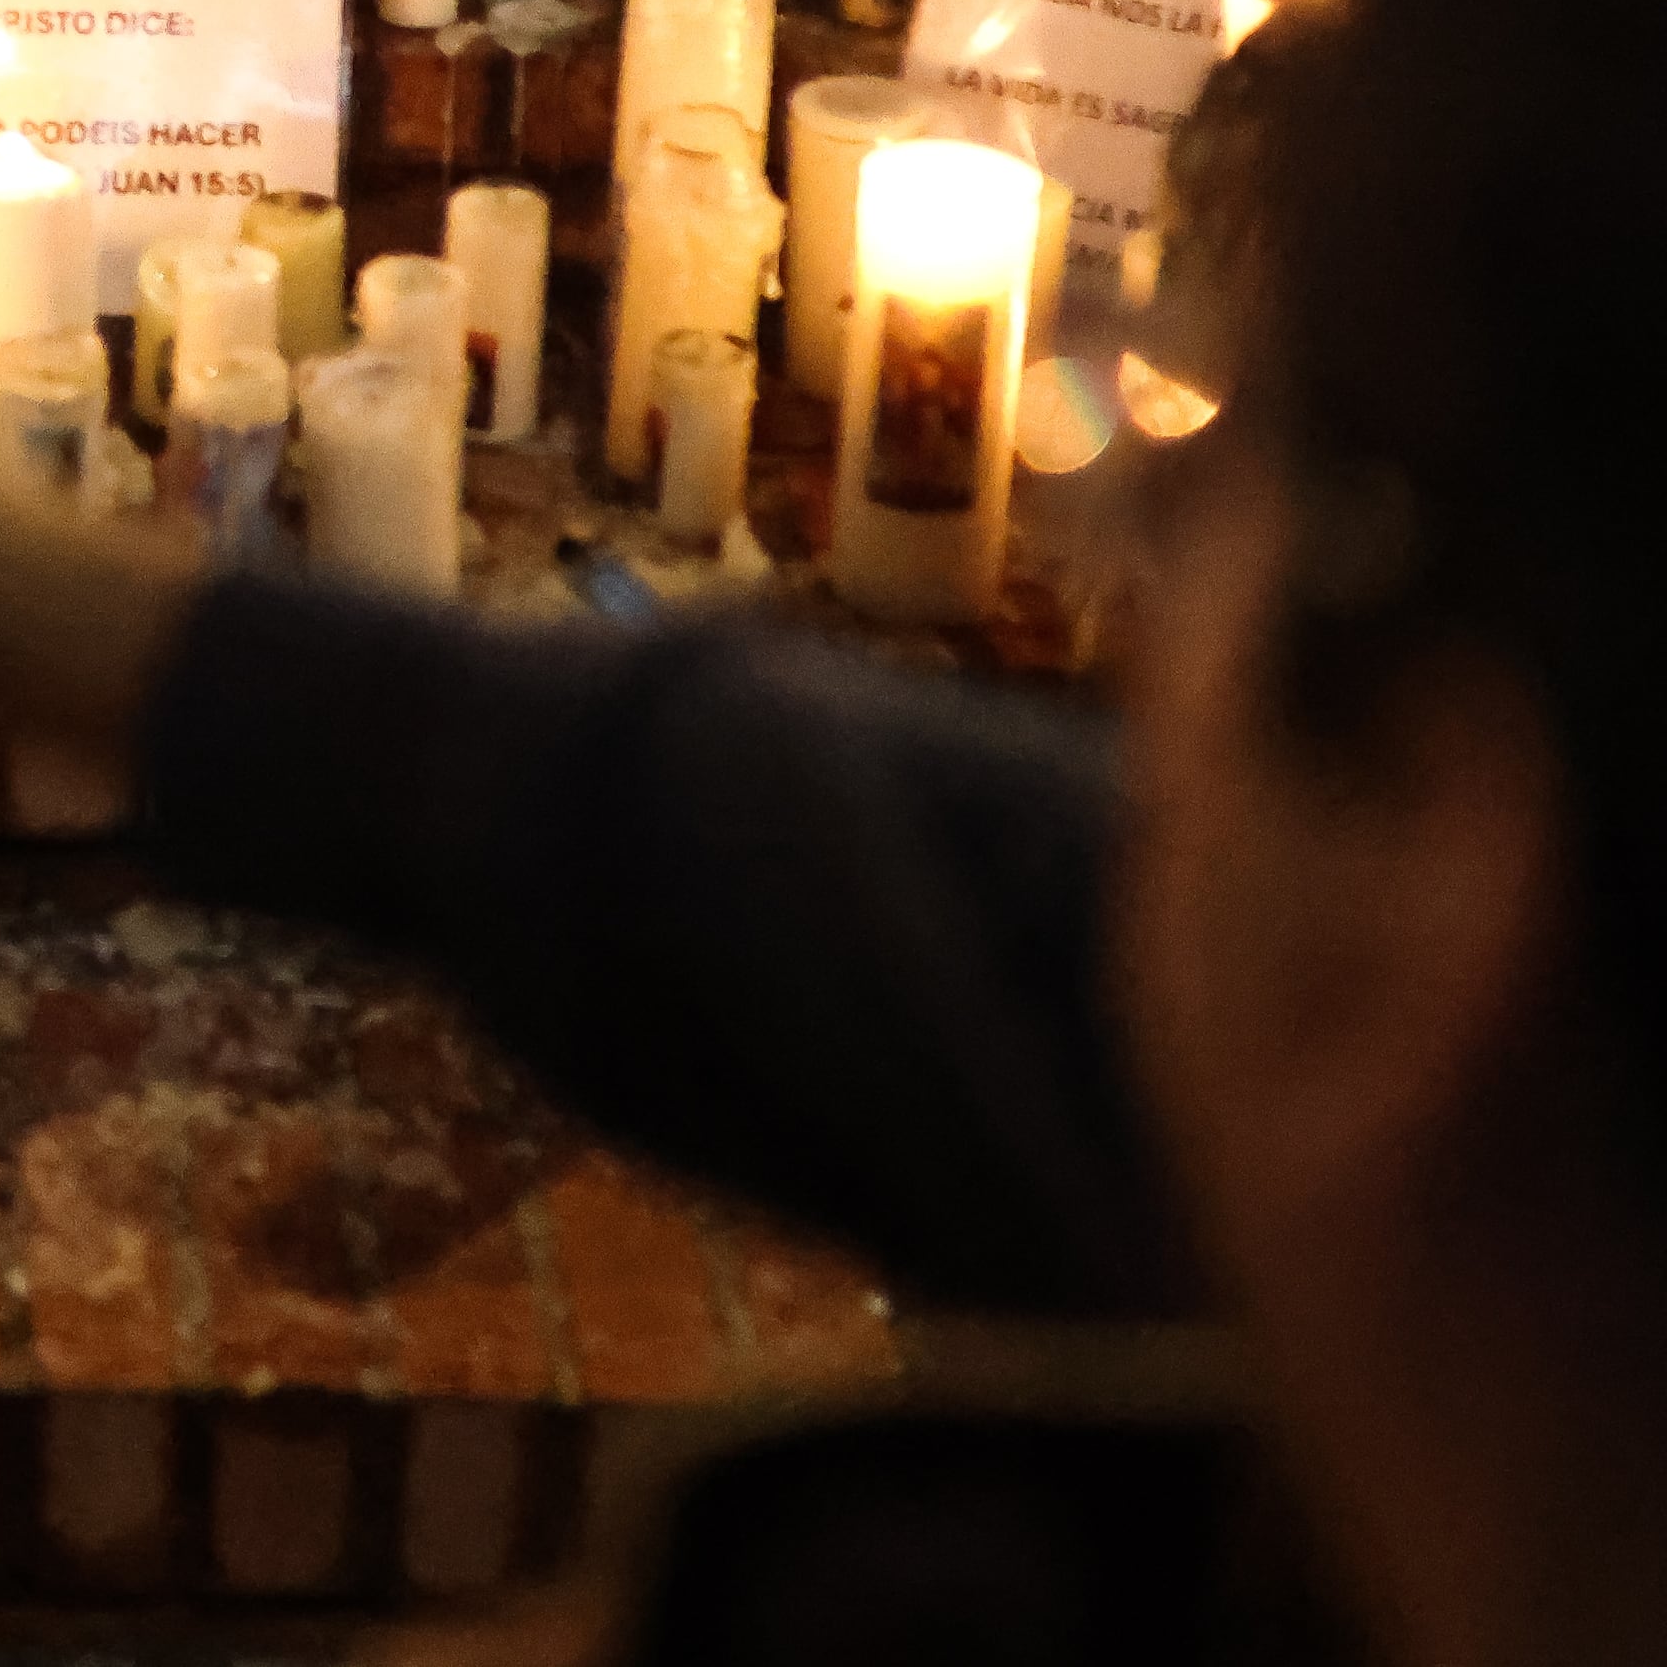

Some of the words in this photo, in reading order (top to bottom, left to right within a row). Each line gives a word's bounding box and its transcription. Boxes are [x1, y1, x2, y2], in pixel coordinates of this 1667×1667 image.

[104, 10, 196, 37] DICE:
[146, 120, 264, 148] HACER
[97, 169, 181, 196] JUAN
